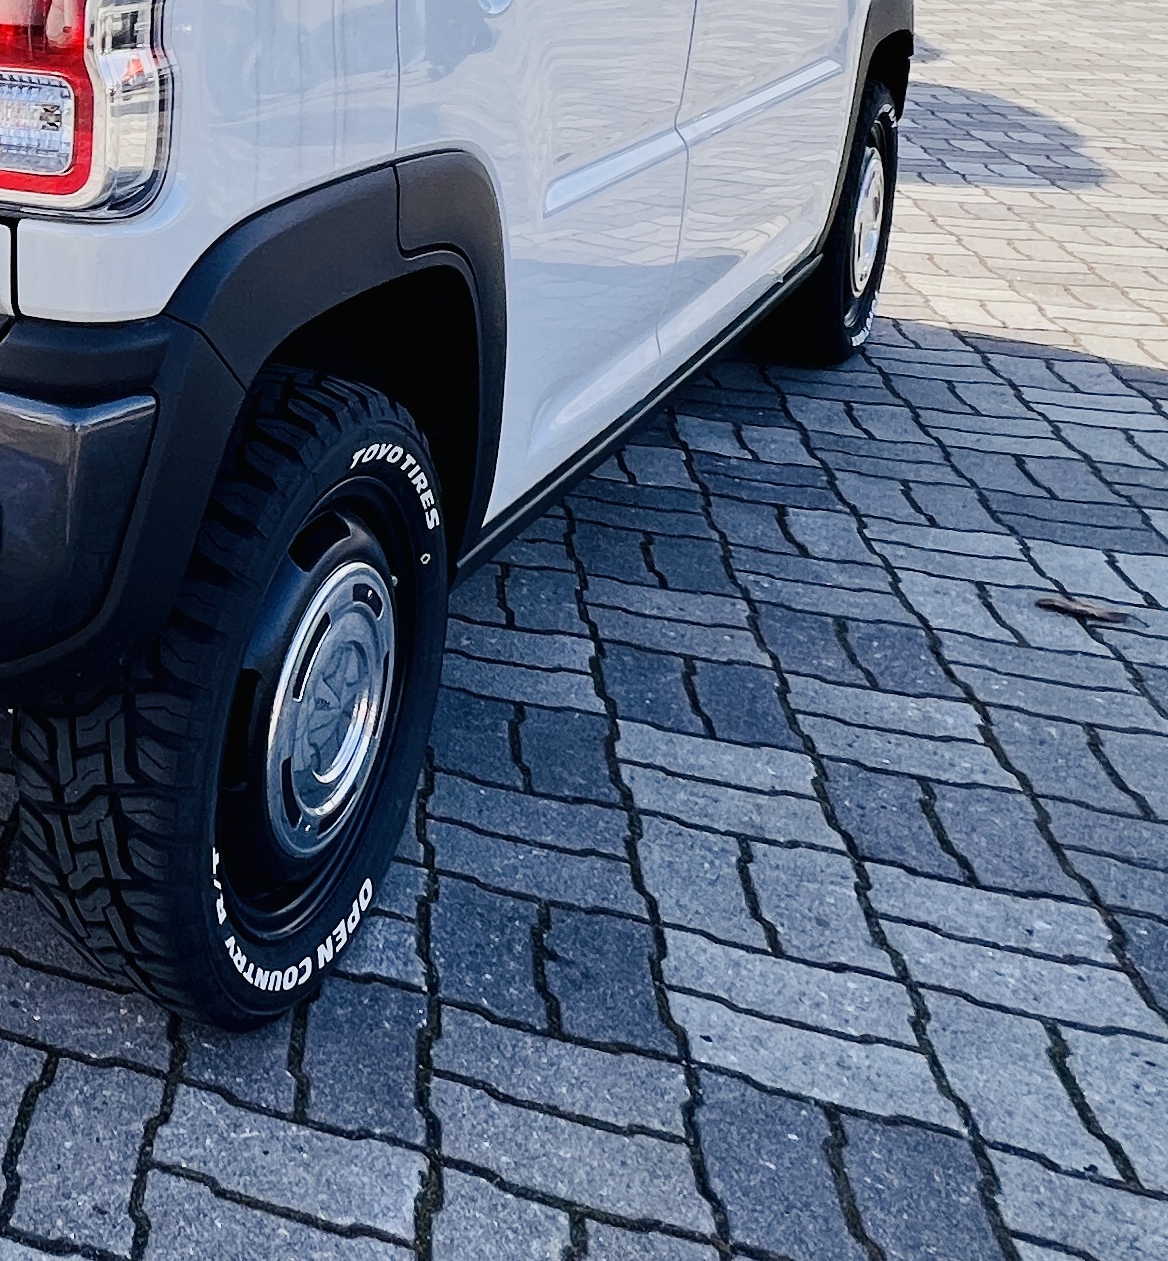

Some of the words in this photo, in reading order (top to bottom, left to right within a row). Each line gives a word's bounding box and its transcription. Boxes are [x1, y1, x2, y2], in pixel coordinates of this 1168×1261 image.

[350, 443, 404, 470] TOYO
[400, 453, 440, 530] TIRES
[224, 935, 312, 991] COUNTRY
[316, 877, 373, 969] OPEN
